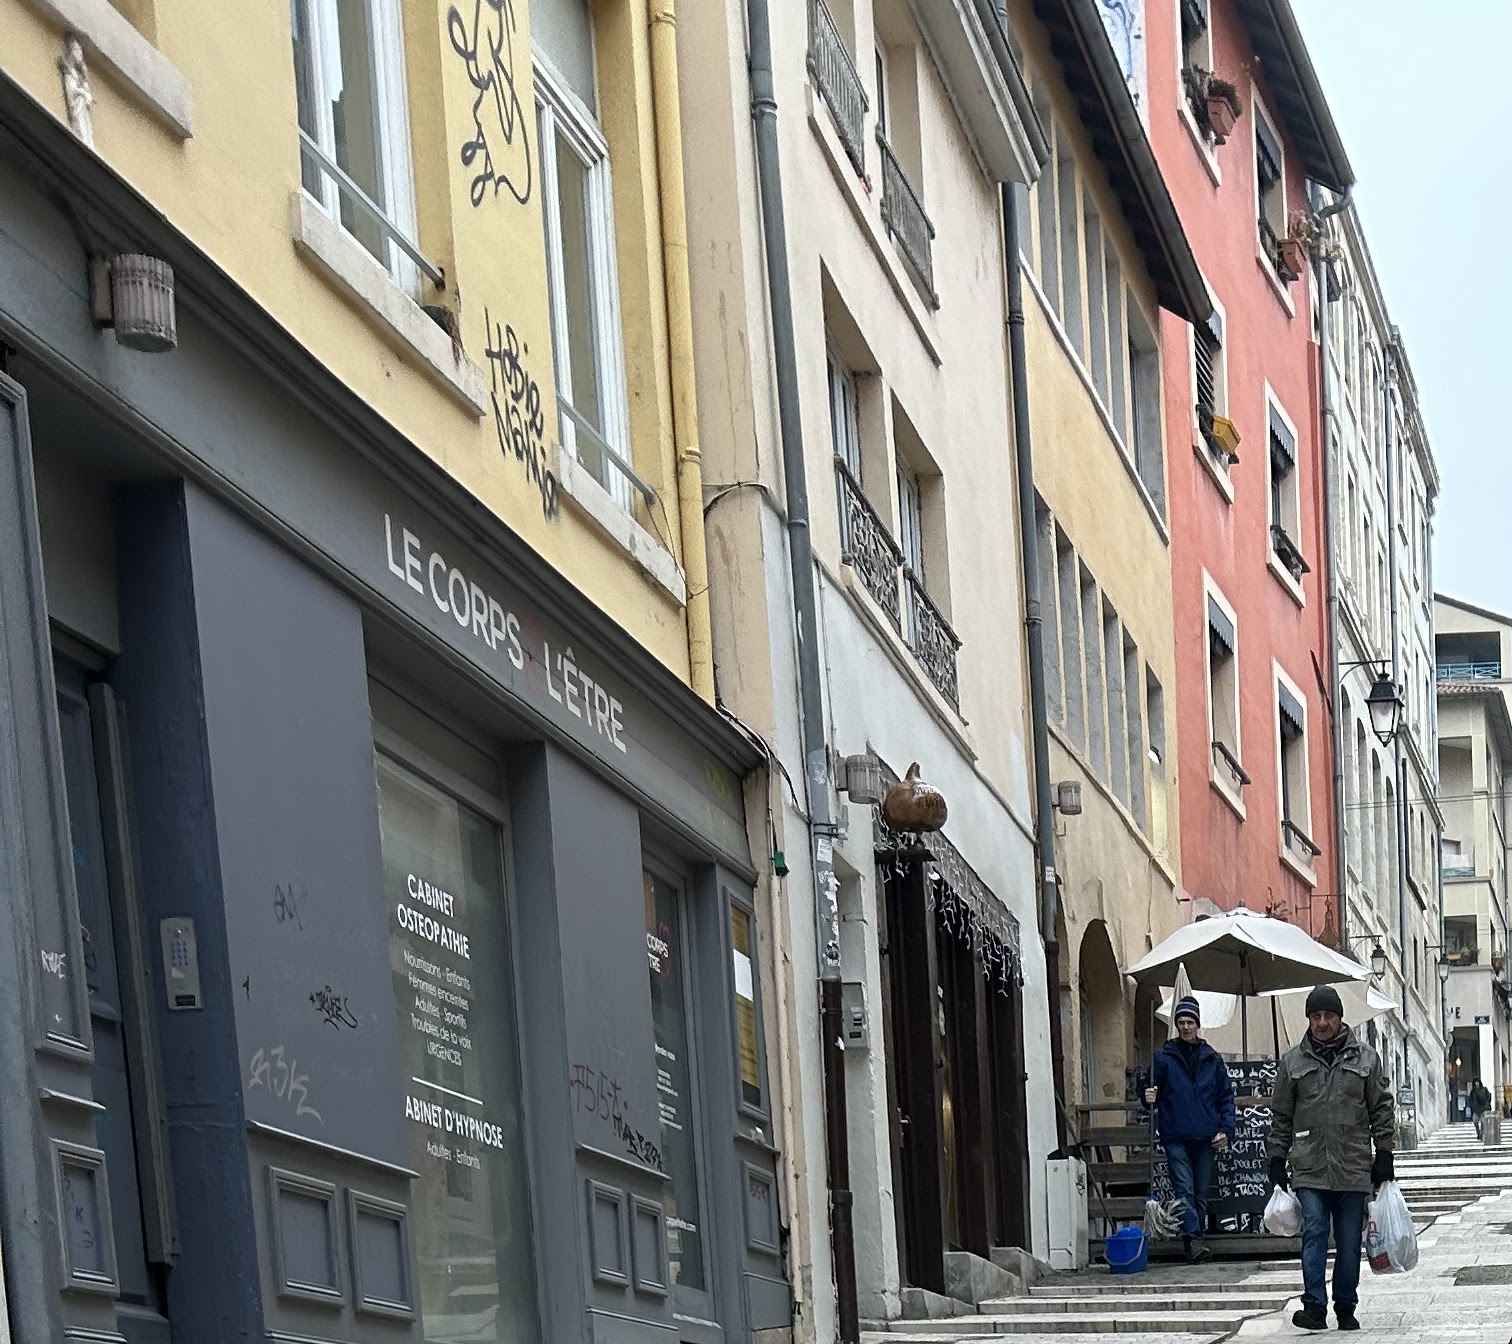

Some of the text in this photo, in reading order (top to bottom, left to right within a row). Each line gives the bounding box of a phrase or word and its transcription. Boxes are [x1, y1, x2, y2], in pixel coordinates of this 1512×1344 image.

[384, 513, 627, 753] LE CORPS L'ÊTRE
[407, 874, 454, 918] CABINET
[397, 903, 470, 959] OSTEOPATHIE
[408, 972, 469, 1011] Femmes enceintes
[415, 995, 440, 1018] Adultes
[443, 1007, 467, 1029] Sportifs
[410, 1013, 472, 1050] Troubles de la voix
[426, 1040, 462, 1066] URGENCES
[405, 1095, 503, 1149] ABINET D'HYPNOSE
[1235, 1128, 1264, 1138] ALAFEL
[426, 1141, 452, 1161] Adultes
[456, 1148, 480, 1170] Enfants
[1231, 1140, 1267, 1158] KEFTA
[1236, 1184, 1265, 1196] TACOS
